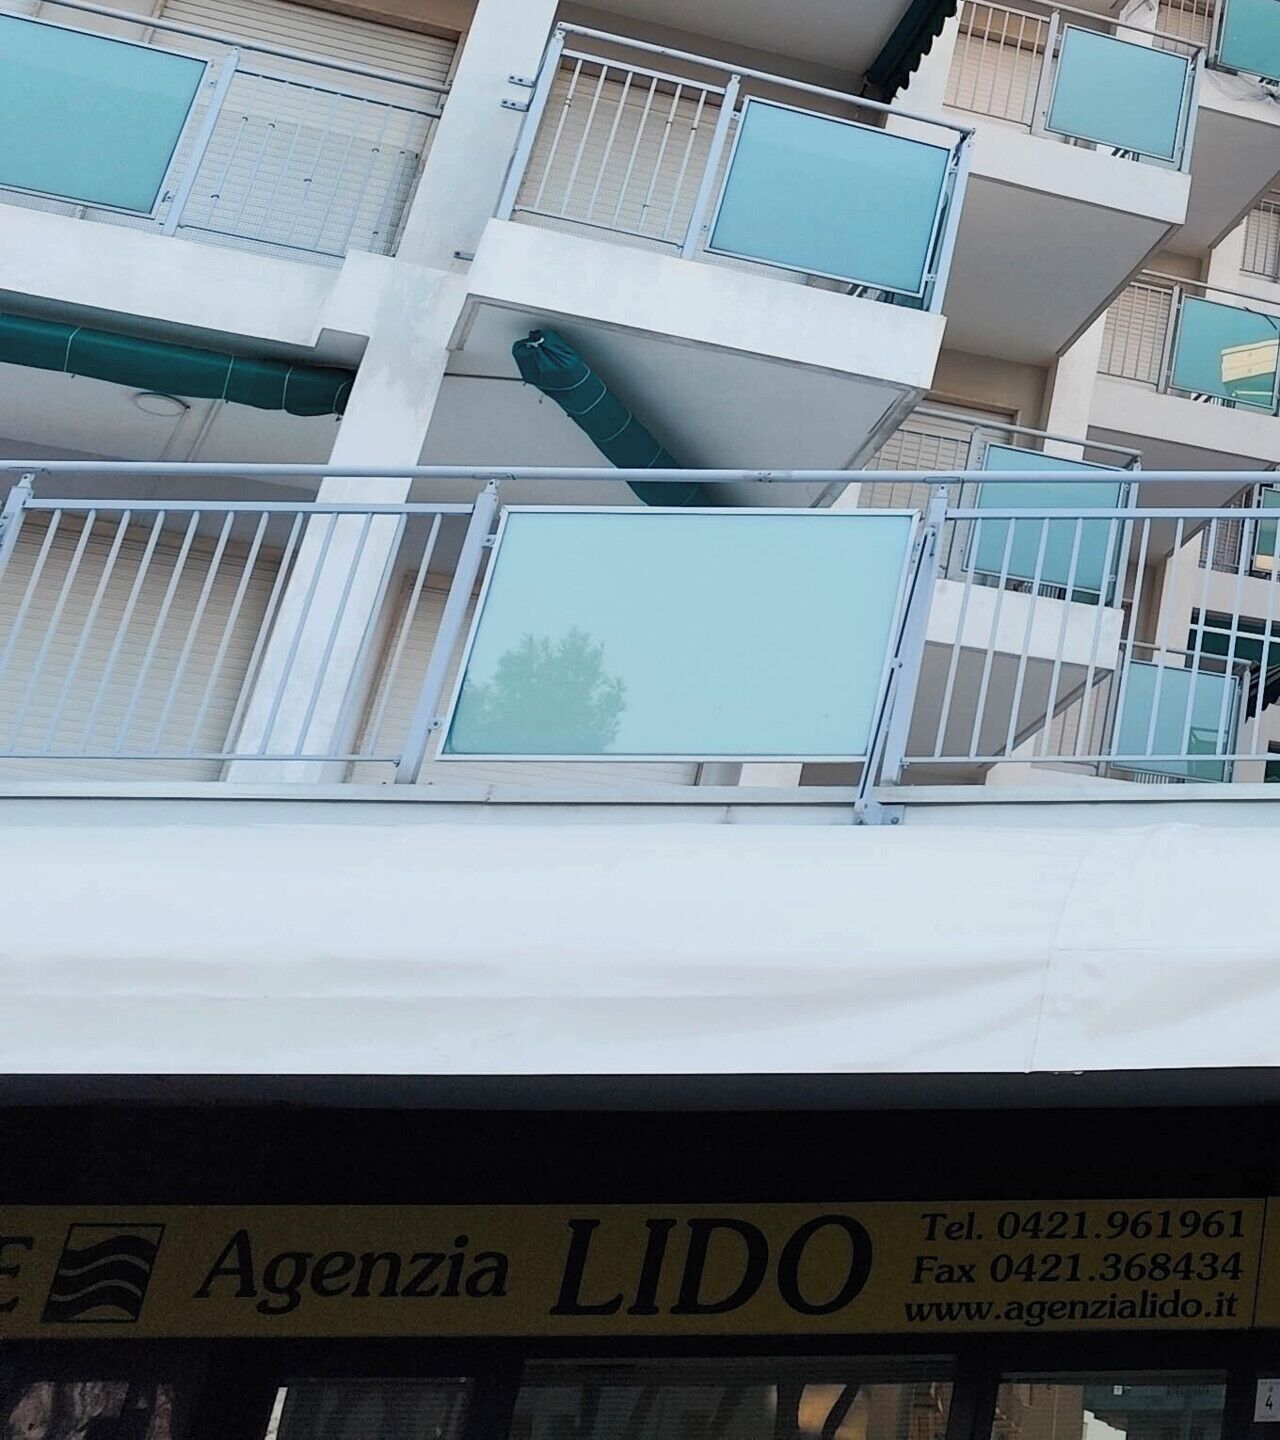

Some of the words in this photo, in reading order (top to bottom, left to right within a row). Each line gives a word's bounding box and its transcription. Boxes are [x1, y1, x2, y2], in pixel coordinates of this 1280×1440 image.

[920, 1211, 984, 1241] Tel.
[997, 1209, 1246, 1241] 0421.961961
[193, 1229, 509, 1316] Agenzia
[549, 1214, 873, 1316] LIDO
[911, 1256, 977, 1285] Fax
[990, 1252, 1244, 1283] 0421.368434
[904, 1289, 1239, 1328] www.agenzialido.it
[1265, 1394, 1273, 1411] 4
